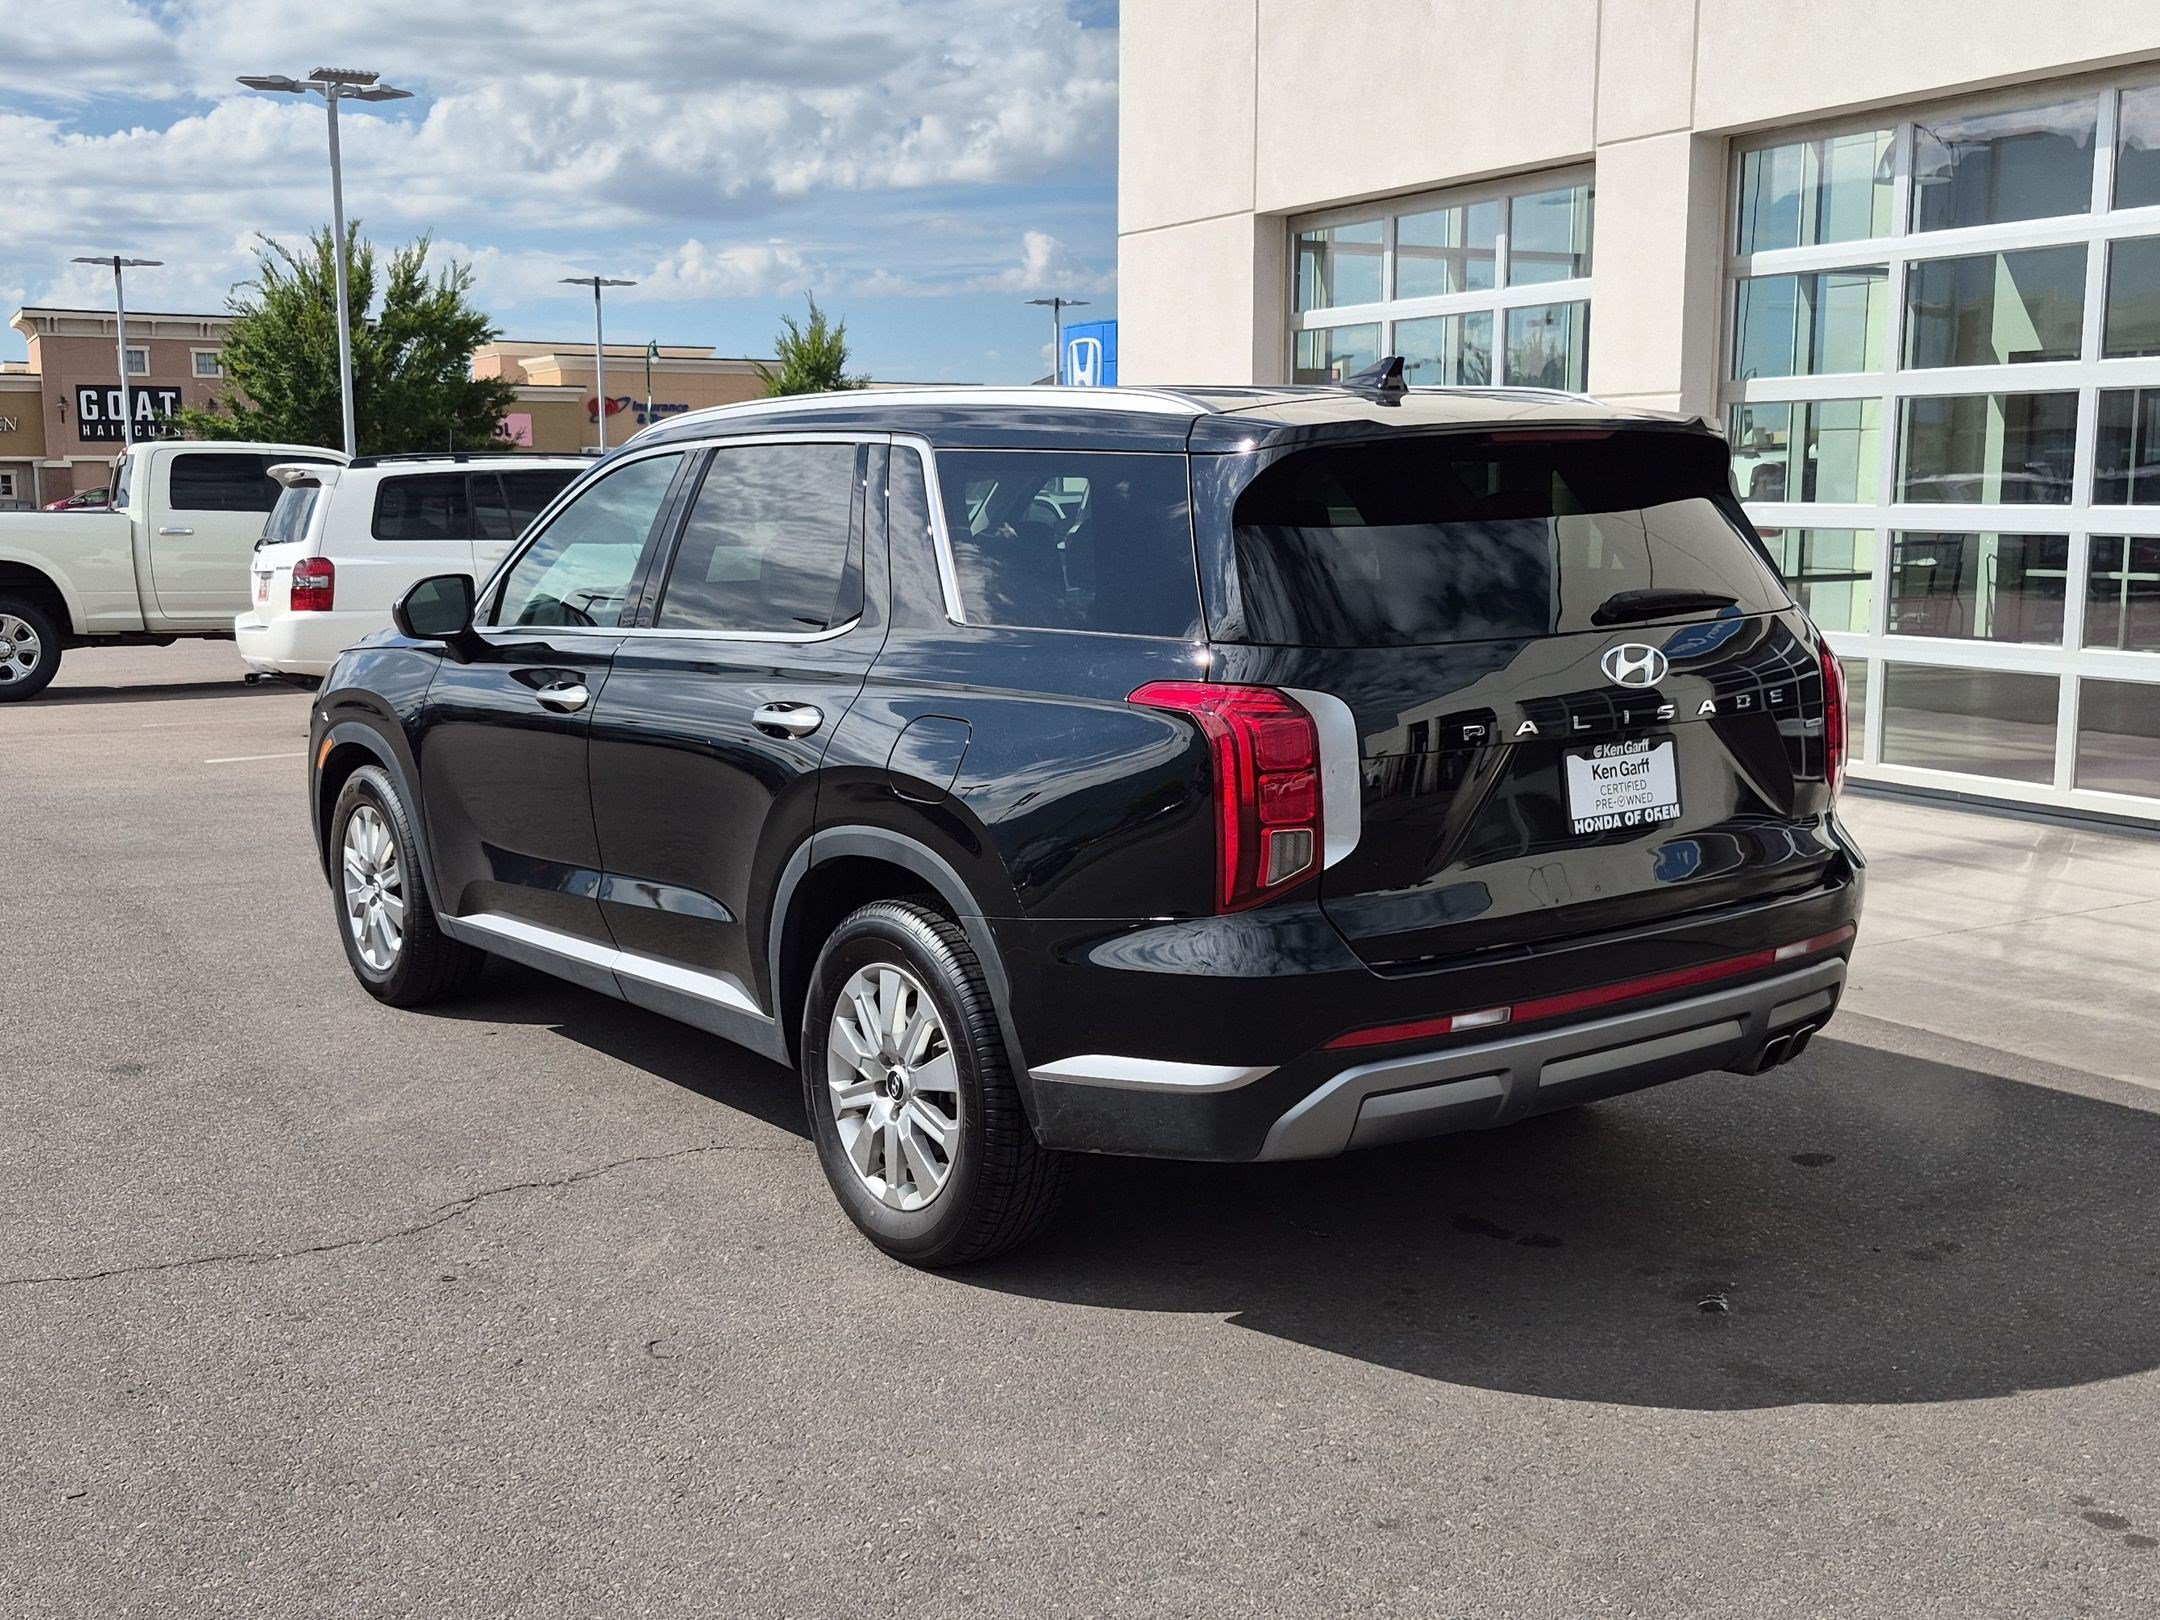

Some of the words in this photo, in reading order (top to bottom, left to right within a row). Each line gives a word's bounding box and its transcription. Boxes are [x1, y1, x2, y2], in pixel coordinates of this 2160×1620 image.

[1463, 689, 1783, 741] PALISADE
[1591, 763, 1618, 781] Ken
[1619, 757, 1650, 777] Garff
[1600, 779, 1647, 796] CERTIFIED
[1574, 814, 1622, 835] HONDA
[1624, 810, 1642, 826] OF
[1644, 803, 1681, 823] OREM
